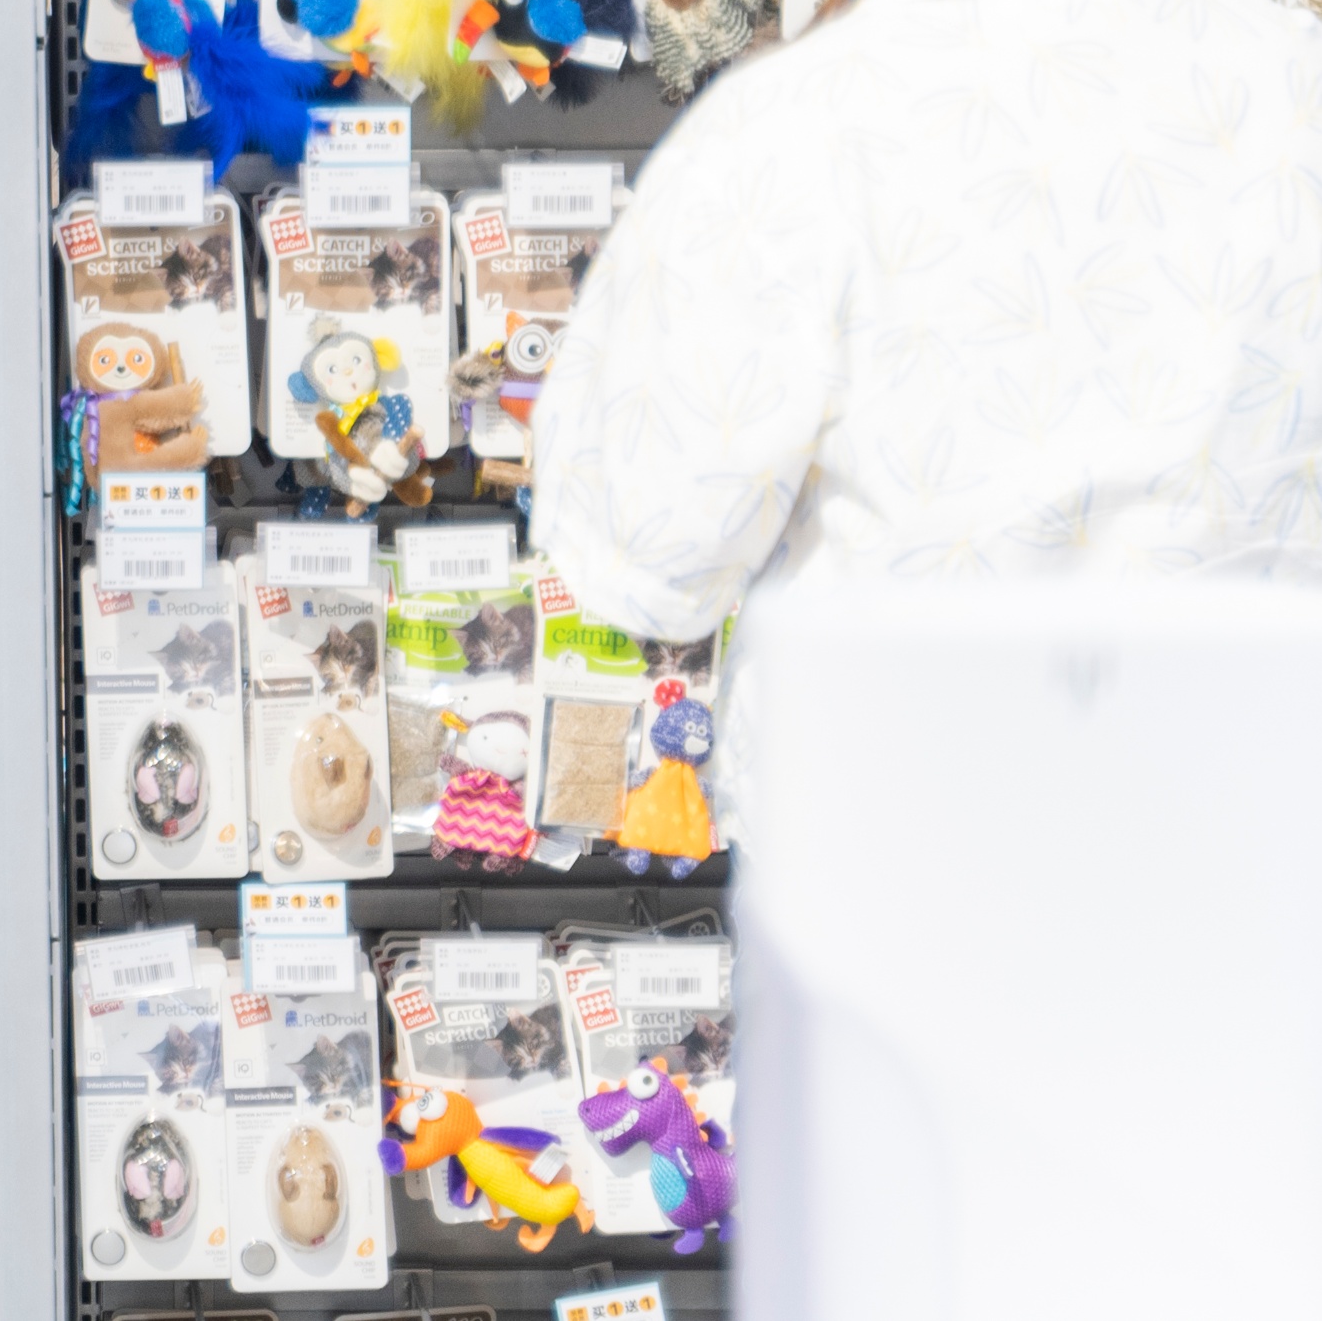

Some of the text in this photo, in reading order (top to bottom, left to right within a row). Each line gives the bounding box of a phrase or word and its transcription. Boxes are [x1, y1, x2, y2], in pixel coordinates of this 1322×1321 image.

[340, 121, 401, 136] 买1送1
[70, 243, 98, 256] GiGwi
[113, 241, 156, 254] CATCH
[278, 239, 306, 252] GiGwi
[321, 239, 365, 252] CATCH
[475, 240, 503, 253] GiGwi
[519, 239, 562, 251] CATCH
[87, 255, 163, 276] scratch
[293, 252, 370, 273] scratch
[491, 253, 568, 273] scratch
[135, 486, 196, 501] 买1送1
[102, 599, 131, 614] GiGwi
[167, 601, 229, 616] PetDroid
[319, 603, 373, 617] PetDroid
[545, 598, 573, 611] GiGwi
[387, 620, 448, 649] atnip
[552, 627, 628, 654] catnip
[97, 680, 156, 689] Interactive Mouse
[275, 895, 336, 909] 买1送1
[156, 1001, 218, 1017] PetDroid
[448, 1009, 489, 1022] CATCH
[240, 1011, 269, 1025] GiGwi
[304, 1013, 368, 1027] PetDroid
[406, 1012, 432, 1027] GiGwi
[586, 1013, 615, 1027] GiGwi
[632, 1013, 676, 1025] CATCH
[425, 1021, 497, 1046] scratch
[606, 1028, 682, 1048] scratch
[87, 1081, 145, 1089] Interactive Mouse
[234, 1092, 294, 1101] Interactive Mouse
[593, 1297, 652, 1318] 买1送1
